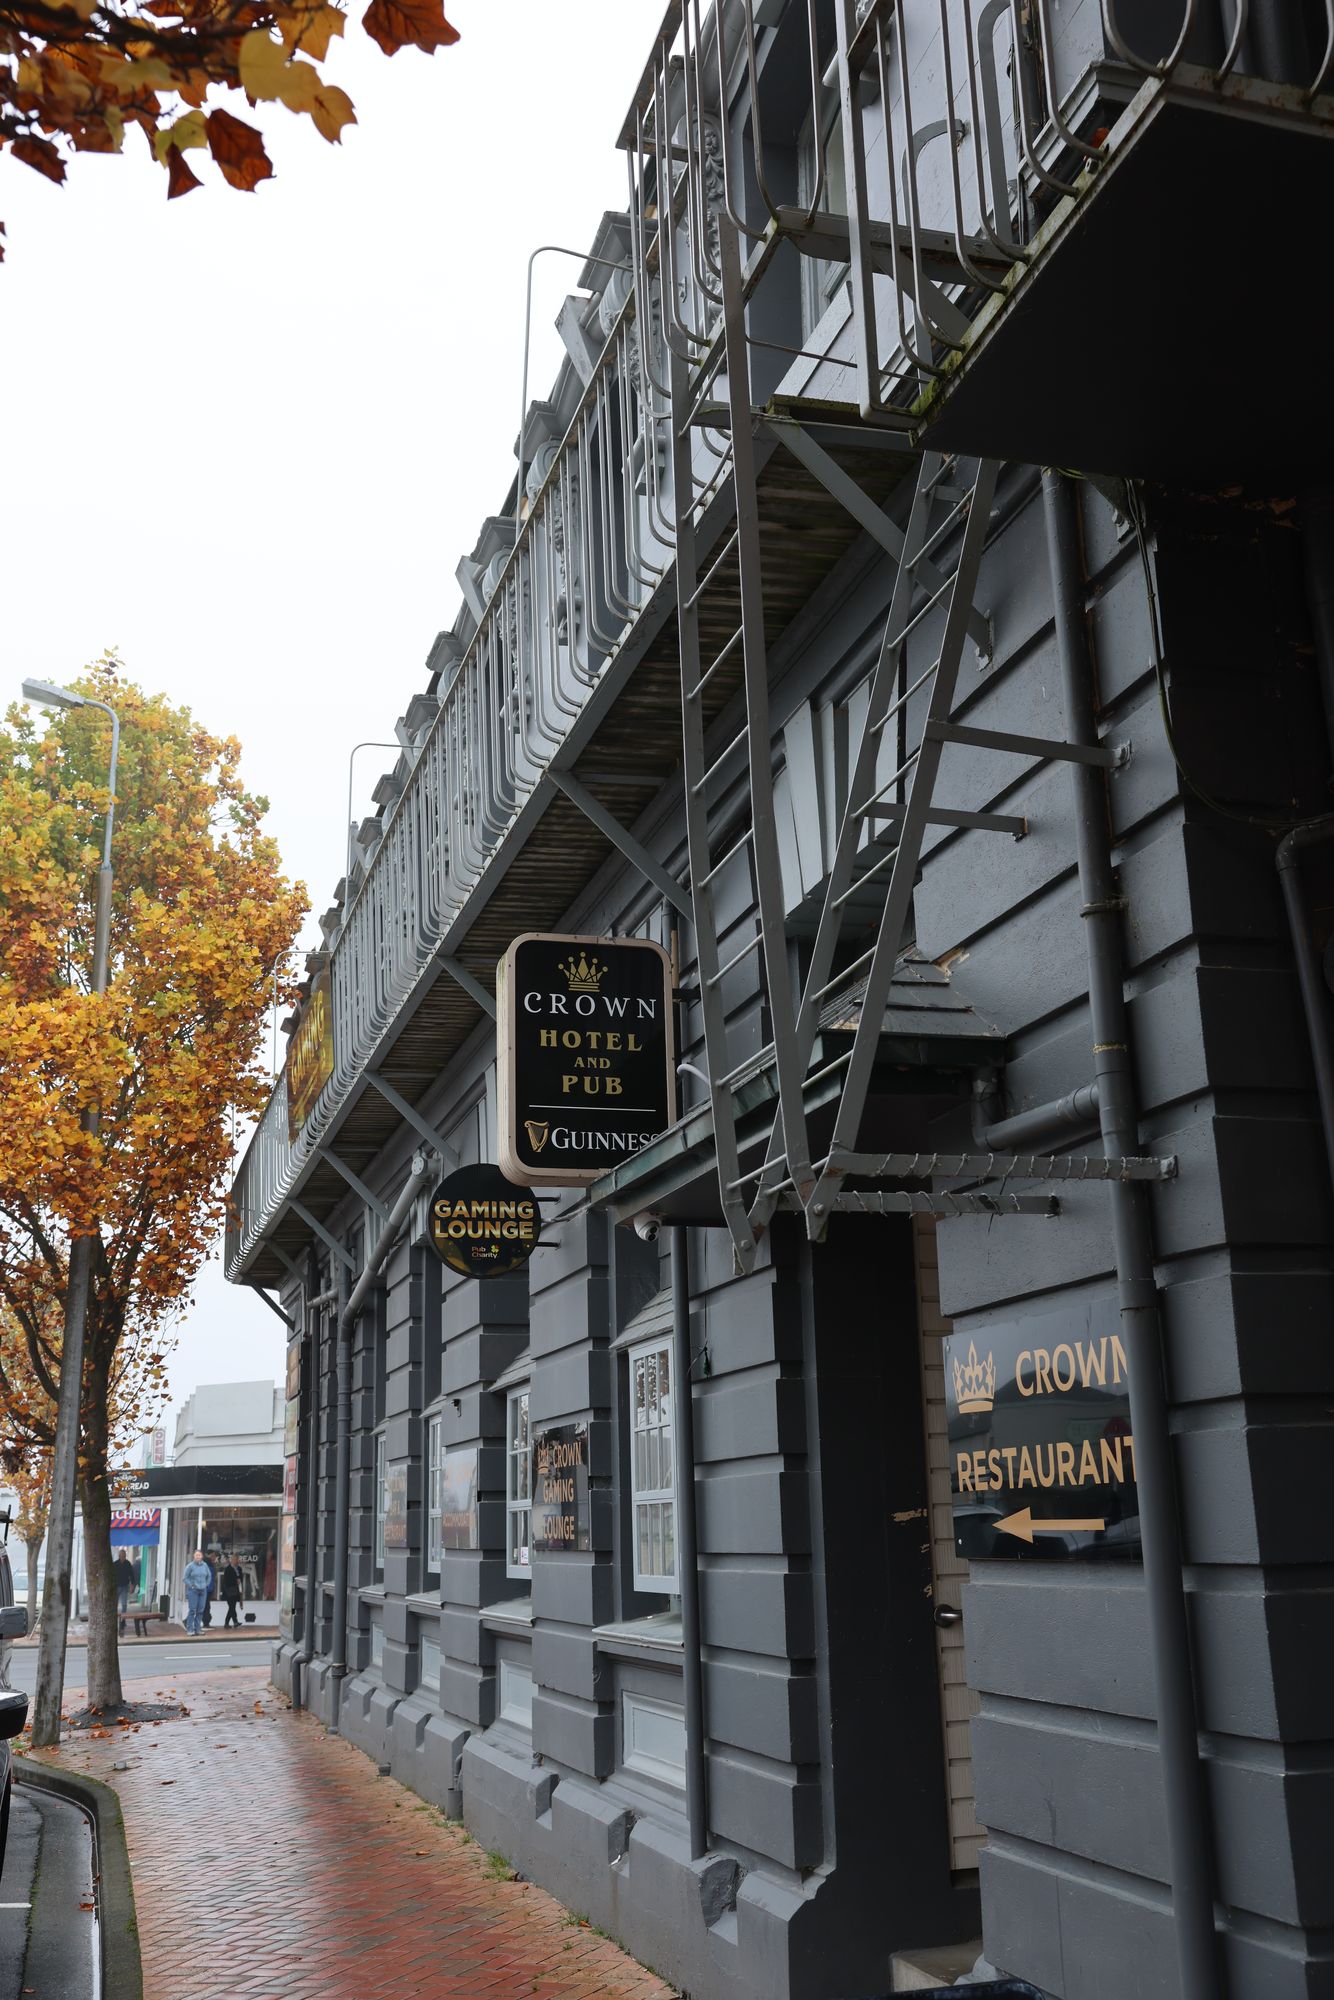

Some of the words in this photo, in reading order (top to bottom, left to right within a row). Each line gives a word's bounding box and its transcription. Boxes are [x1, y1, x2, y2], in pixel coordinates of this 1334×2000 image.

[523, 991, 657, 1019] CROWN
[540, 1029, 643, 1051] HOTEL
[574, 1056, 611, 1069] AND
[562, 1075, 623, 1095] PUB
[434, 1199, 534, 1220] GAMING
[434, 1219, 534, 1239] LOUNGE
[1015, 1335, 1128, 1396] CROWN
[155, 1431, 163, 1462] OPEN
[553, 1442, 582, 1467] CROWN
[543, 1478, 574, 1505] GAMING
[543, 1515, 575, 1540] LOUNGE
